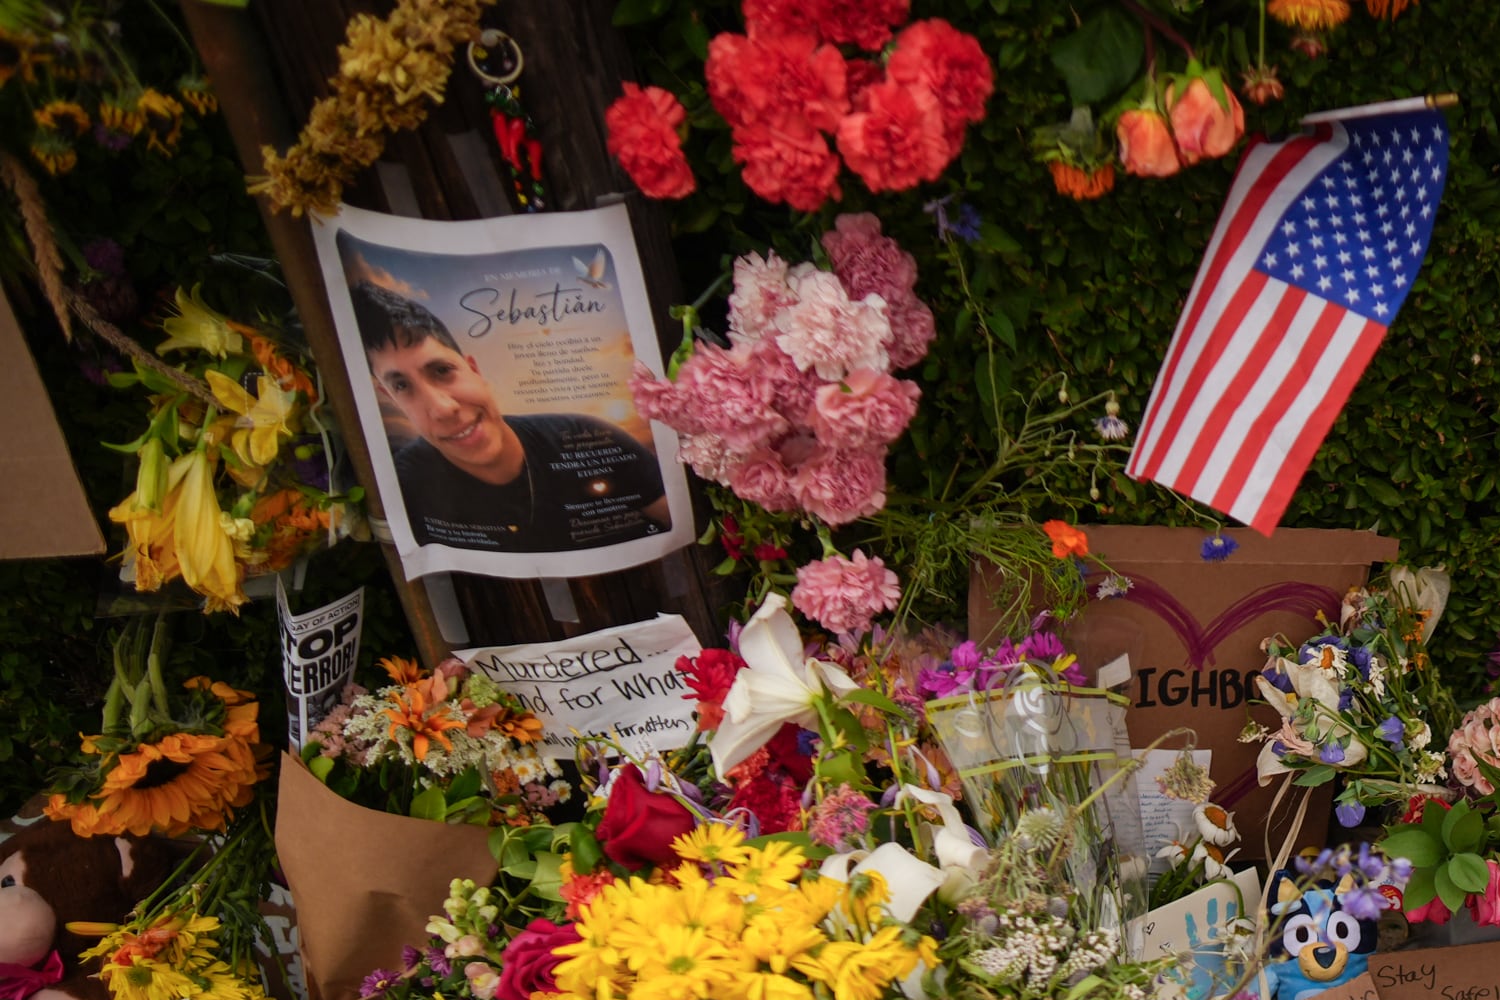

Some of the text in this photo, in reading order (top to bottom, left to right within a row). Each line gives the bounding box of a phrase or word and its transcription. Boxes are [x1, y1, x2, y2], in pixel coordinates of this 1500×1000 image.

[312, 616, 326, 626] OF
[327, 599, 360, 620] ACTION
[284, 612, 358, 660] TOP
[515, 685, 554, 716] nd
[559, 687, 602, 712] for
[1377, 964, 1436, 990] Stay
